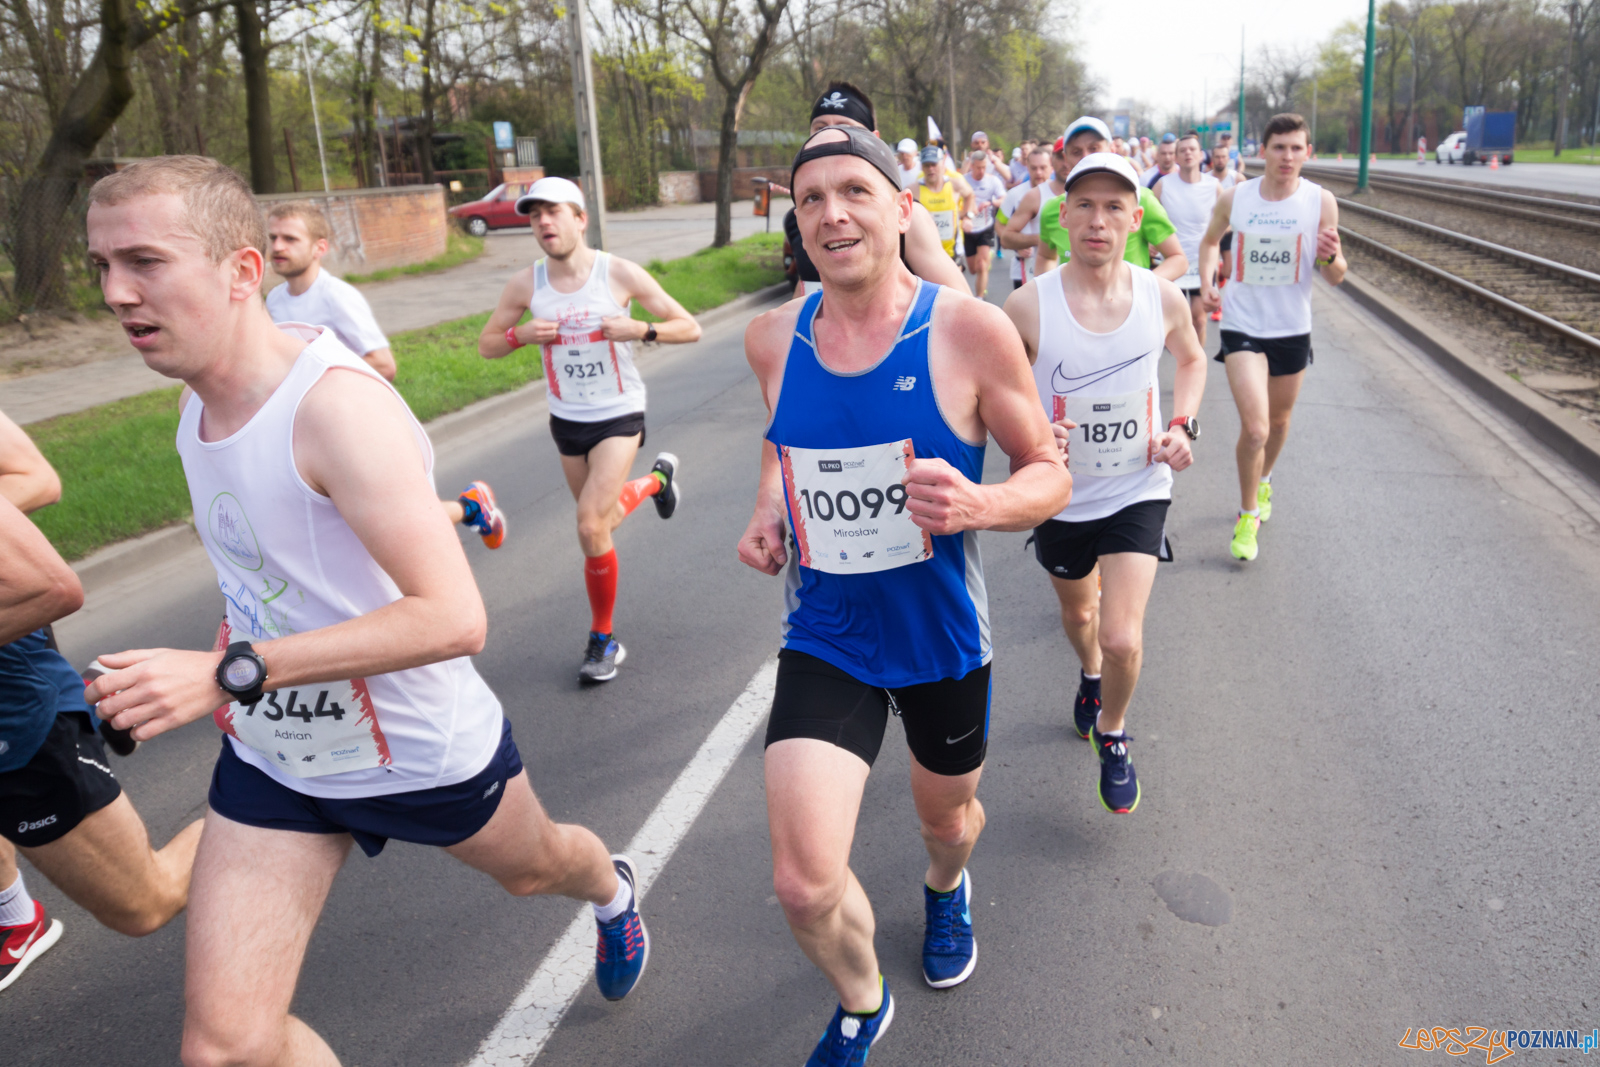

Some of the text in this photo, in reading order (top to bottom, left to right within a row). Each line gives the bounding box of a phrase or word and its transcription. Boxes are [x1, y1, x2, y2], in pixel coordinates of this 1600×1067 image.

[1250, 250, 1291, 264] 8648
[564, 361, 605, 378] 9321
[1080, 418, 1138, 443] 1870
[800, 483, 909, 521] 10099
[833, 528, 879, 537] Mirosław
[274, 729, 313, 741] Adrian
[28, 814, 58, 830] asics
